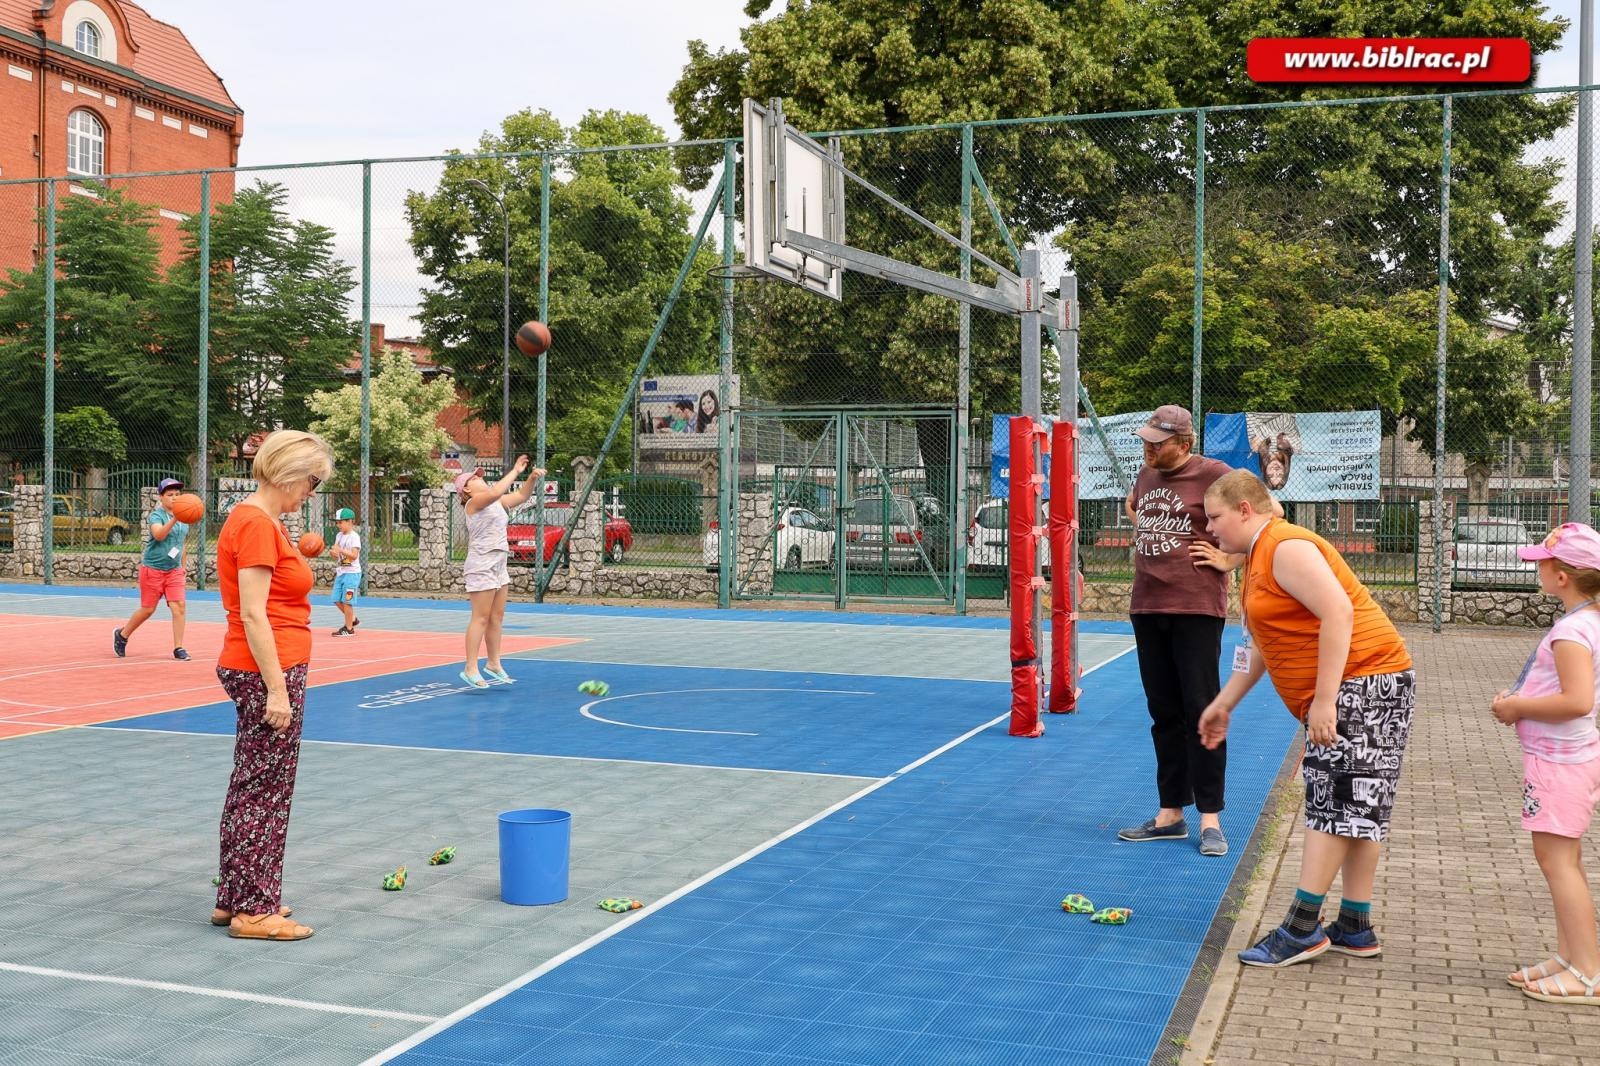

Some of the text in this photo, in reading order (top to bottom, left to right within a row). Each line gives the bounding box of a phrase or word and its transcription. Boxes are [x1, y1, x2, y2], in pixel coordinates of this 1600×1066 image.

[1340, 454, 1373, 463] czasach
[1306, 463, 1363, 473] niestabilnych
[1341, 473, 1373, 481] PRACA
[1328, 482, 1373, 491] STABILNA
[1138, 487, 1184, 512] BROOKLYN
[1145, 502, 1157, 511] EST.
[1141, 532, 1167, 541] SPORTS
